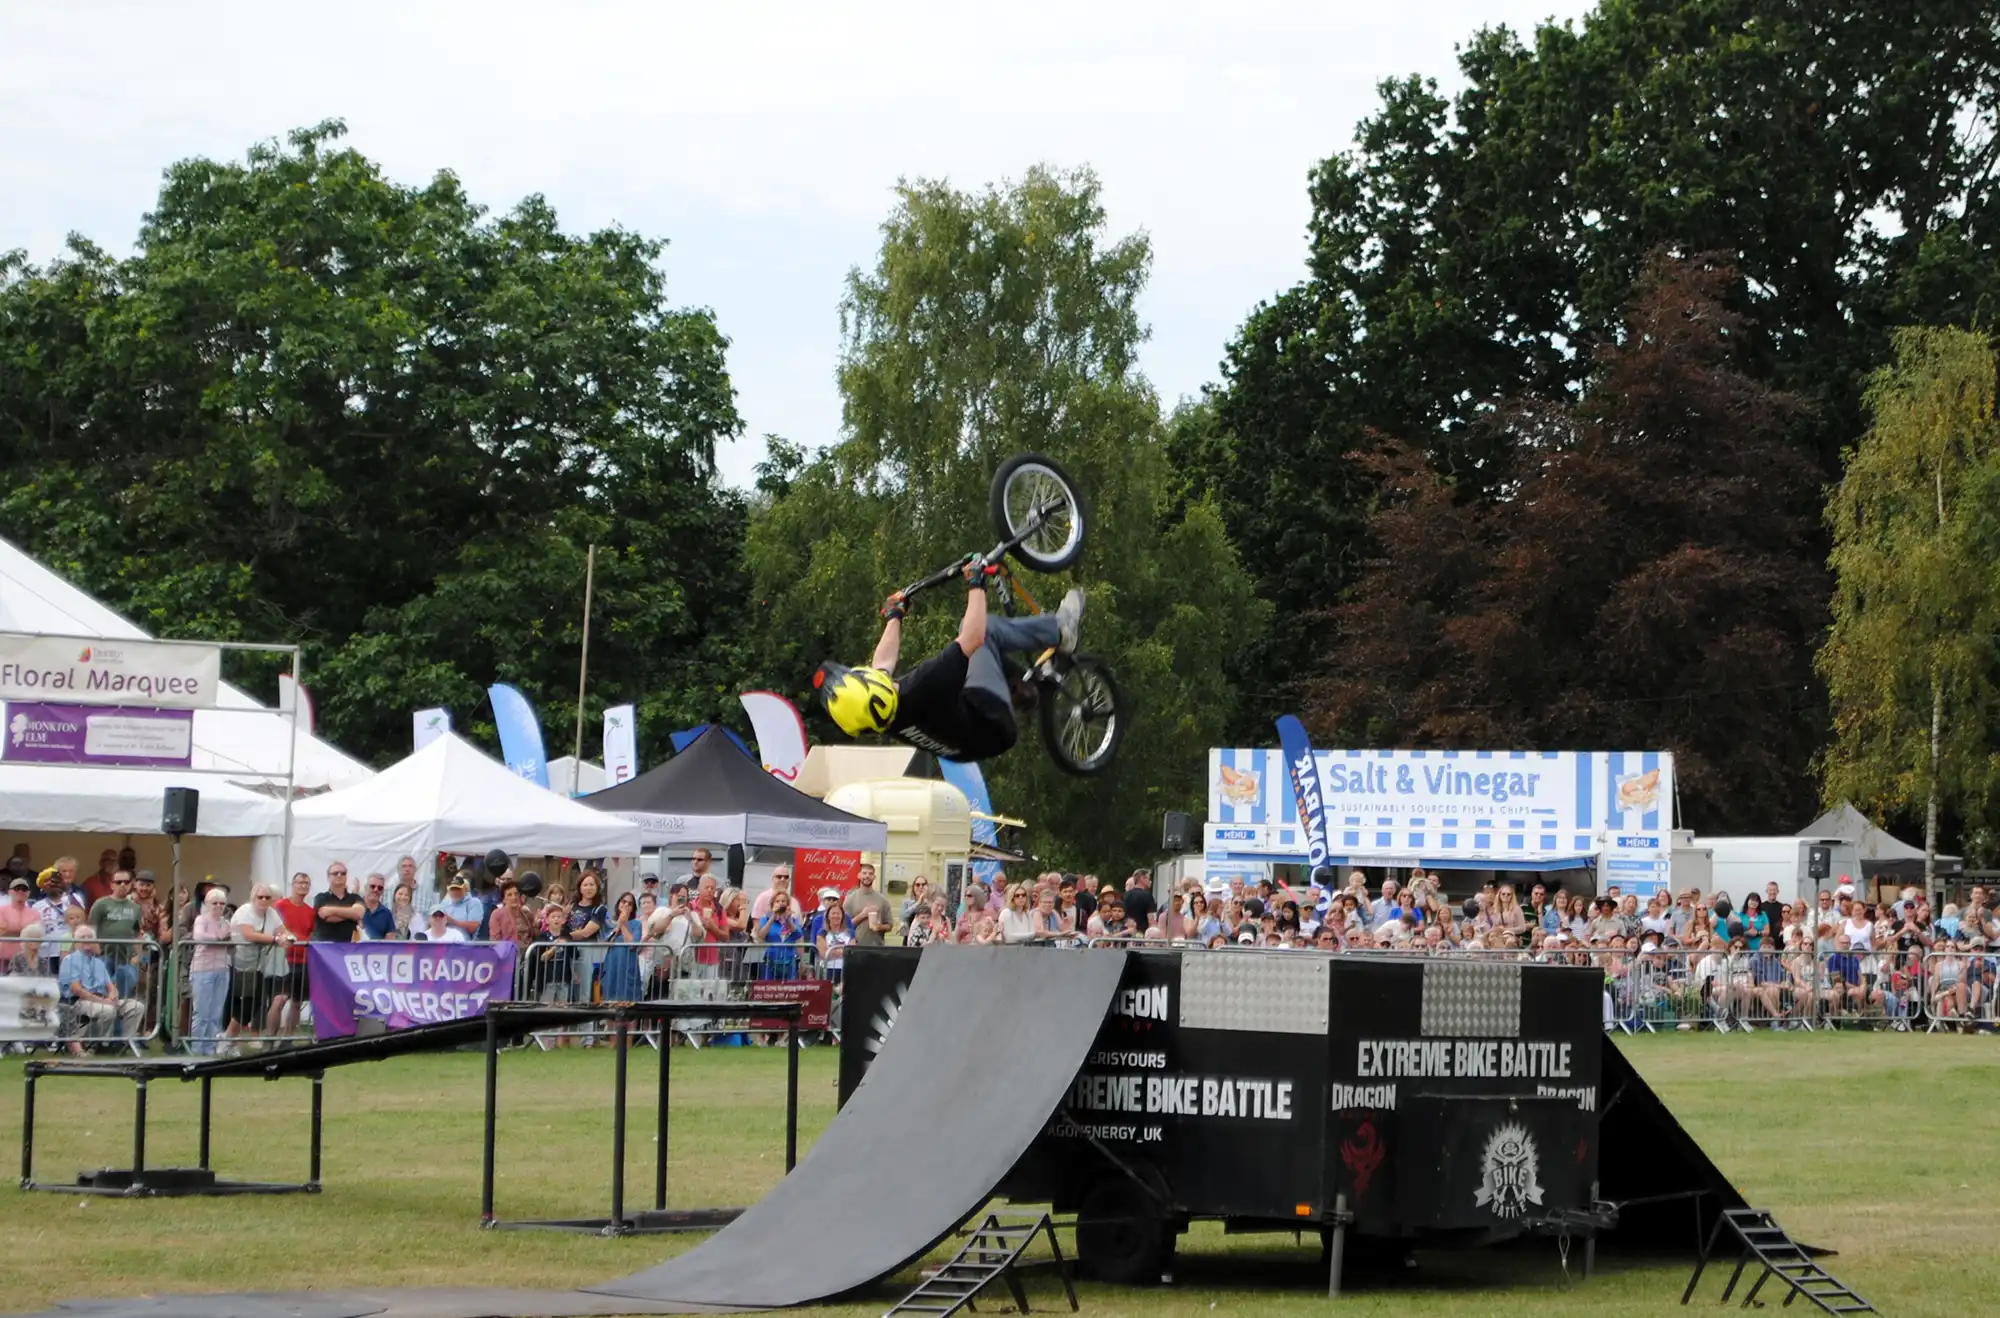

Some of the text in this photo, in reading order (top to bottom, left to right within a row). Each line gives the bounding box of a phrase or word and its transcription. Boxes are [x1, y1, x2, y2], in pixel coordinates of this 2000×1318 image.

[2, 663, 199, 698] Floral Marquee
[25, 731, 47, 743] ELM
[1329, 761, 1541, 803] Salt & Vinegar
[1340, 803, 1406, 813] SUSTAINABLY
[1411, 804, 1458, 814] SOURCED
[1462, 805, 1484, 815] FISH
[1500, 806, 1531, 815] CHIPS
[1223, 831, 1247, 840] MENU
[1625, 838, 1650, 847] MENU
[345, 955, 494, 984] BBC RADIO
[352, 987, 490, 1022] SOMERSET
[1113, 984, 1168, 1022] GON
[1357, 1039, 1572, 1078] EXTREME BIKE BATTLE
[1146, 1076, 1199, 1115] BIKE
[1202, 1078, 1293, 1120] BATTLE
[1331, 1082, 1397, 1111] DRAGON
[1492, 1165, 1528, 1188] BIKE
[1491, 1199, 1528, 1219] BATTLE
